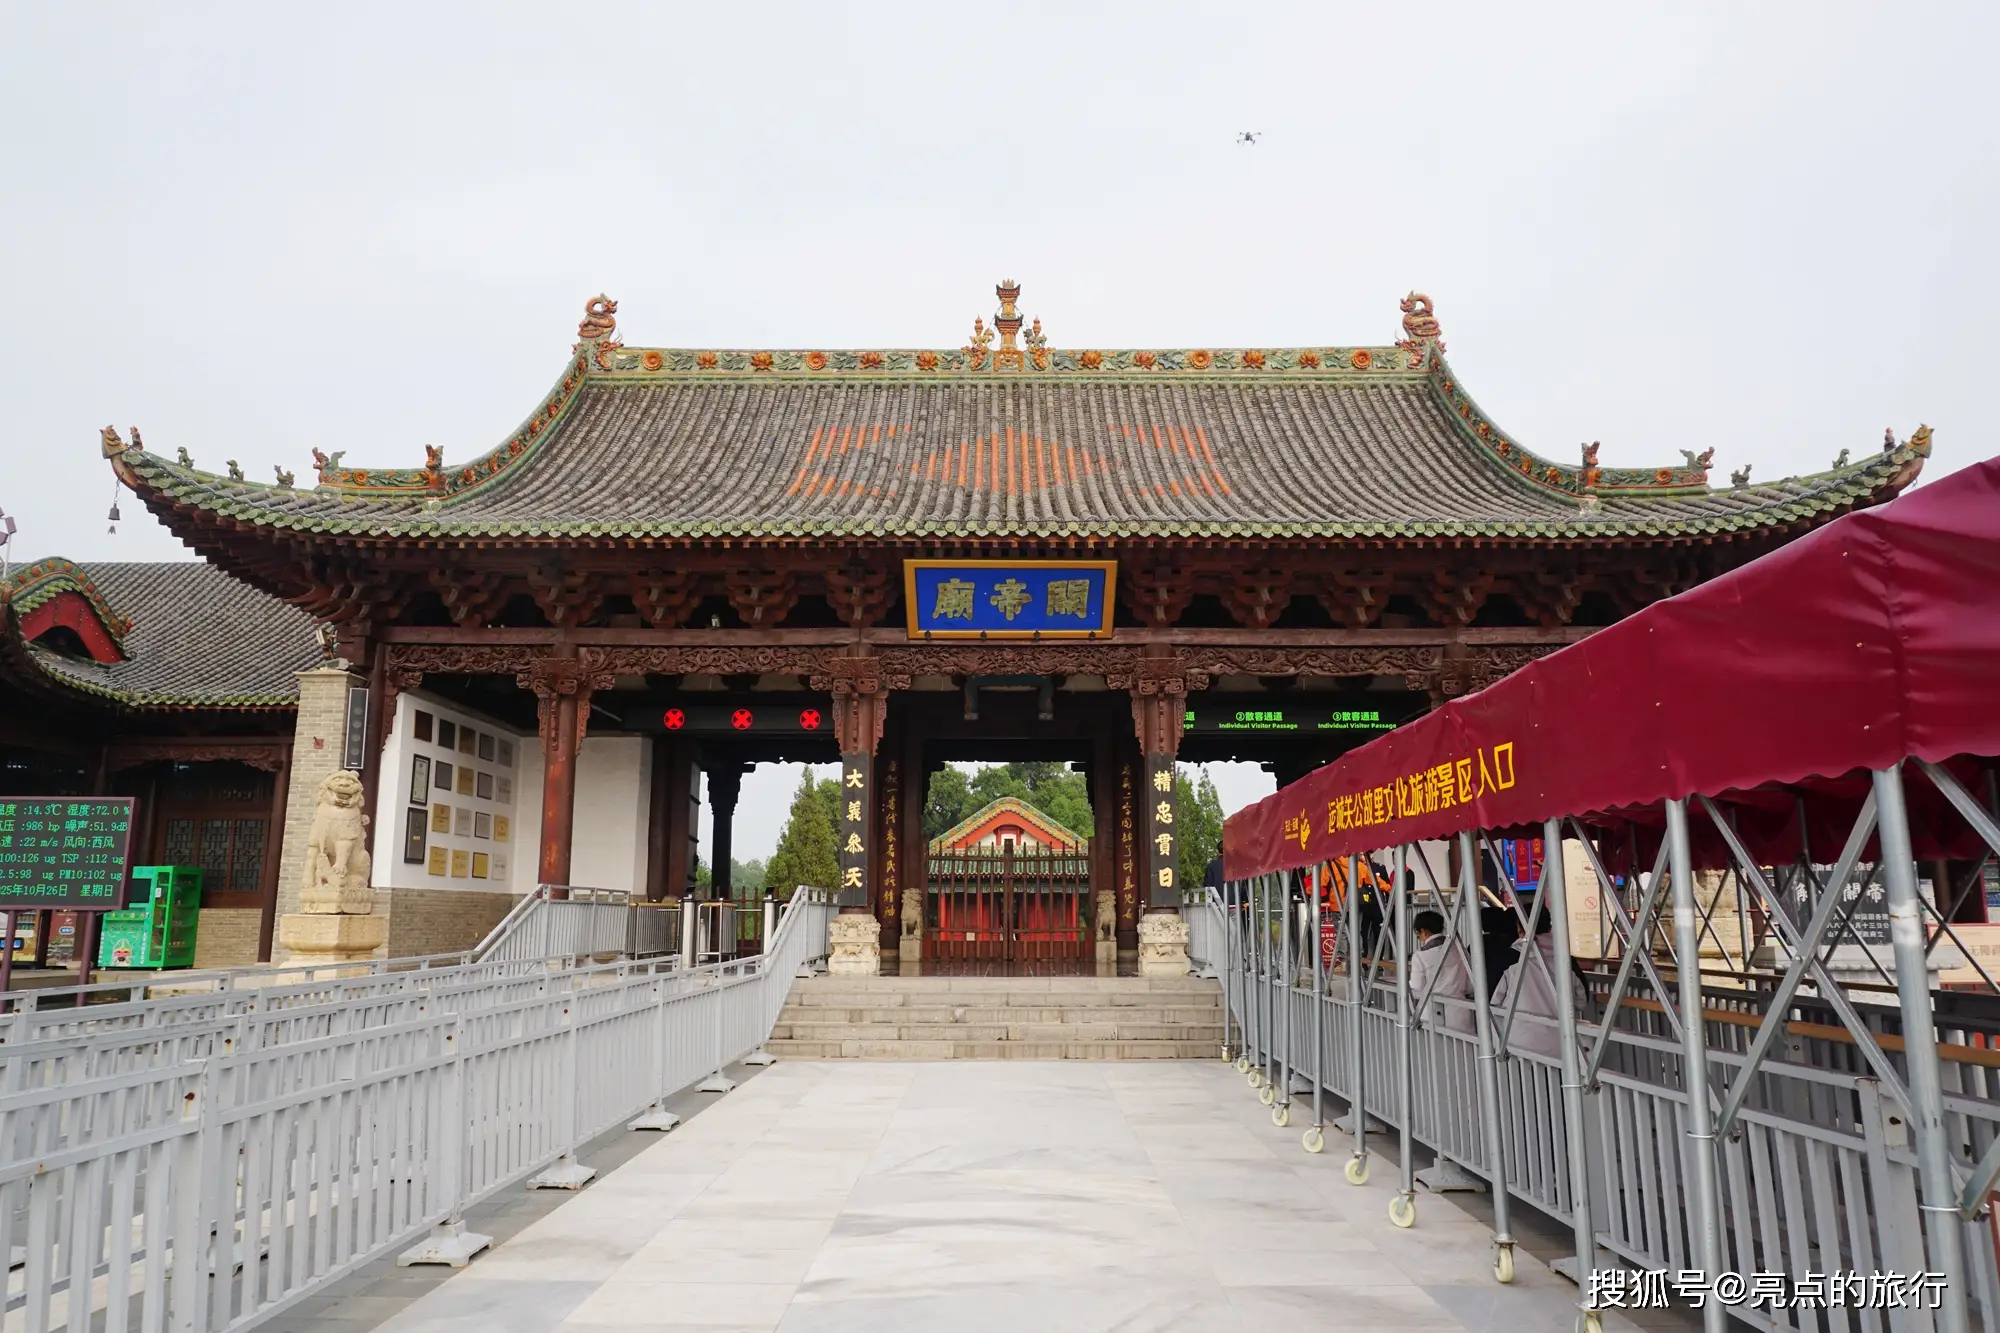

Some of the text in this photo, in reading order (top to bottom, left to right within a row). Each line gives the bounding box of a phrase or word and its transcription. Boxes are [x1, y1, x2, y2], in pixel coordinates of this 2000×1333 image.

[1272, 722, 1298, 730] Passage
[1371, 722, 1397, 730] Passage
[1327, 741, 1515, 834] 运城关公故里文化旅游景区入口
[0, 820, 15, 832] 压
[48, 822, 60, 832] hp
[0, 835, 12, 847] 速
[40, 837, 58, 847] m/s
[44, 855, 56, 864] ug
[61, 854, 79, 863] TSP
[112, 856, 124, 865] ug
[42, 871, 54, 880] ug
[110, 872, 122, 881] ug
[0, 884, 113, 897] 25年10月26日 星期日
